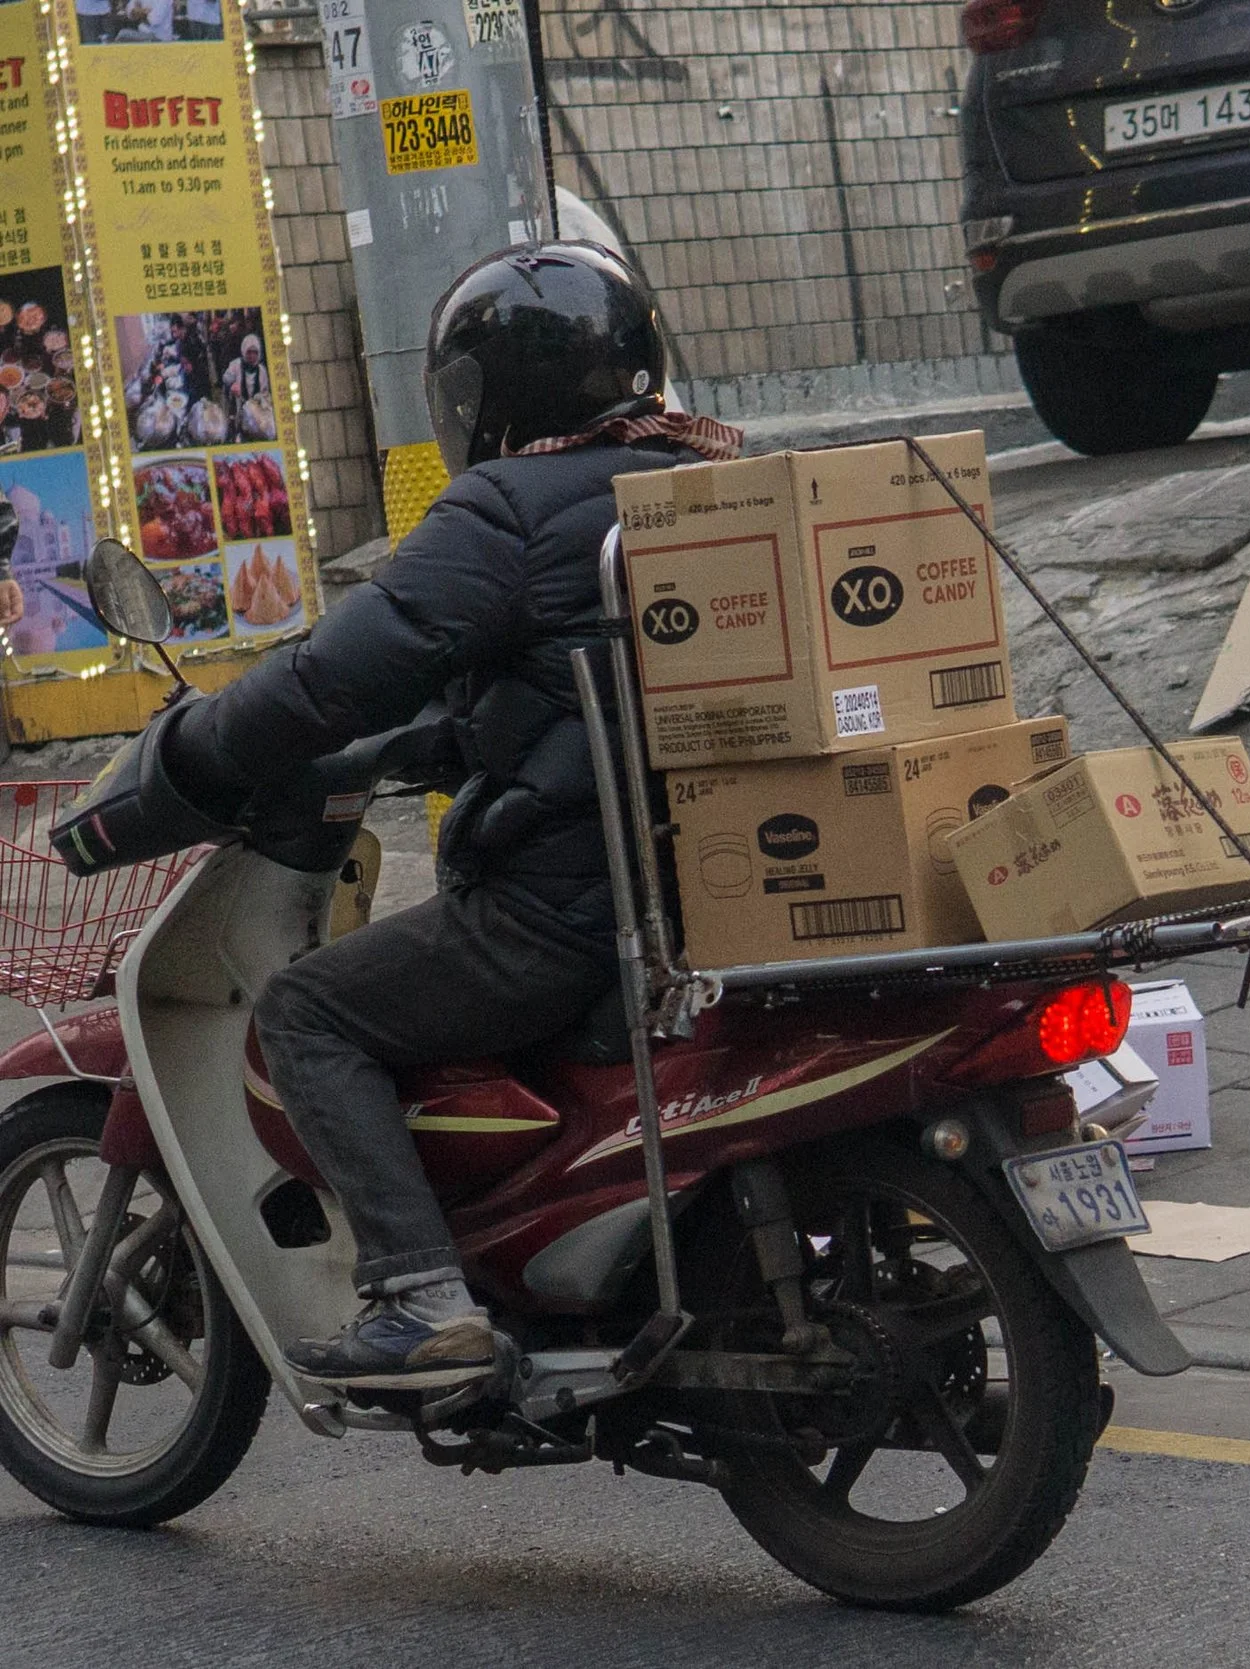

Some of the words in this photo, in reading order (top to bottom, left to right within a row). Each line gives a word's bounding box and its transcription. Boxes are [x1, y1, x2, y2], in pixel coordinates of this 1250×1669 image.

[332, 26, 361, 69] 47
[392, 94, 457, 117] 하나인력
[104, 135, 119, 150] Fri
[121, 134, 157, 150] dinner
[160, 134, 184, 151] only
[186, 132, 204, 147] Sat
[206, 131, 226, 146] and
[166, 155, 188, 171] and
[189, 155, 225, 169] dinner
[160, 181, 173, 193] to
[177, 177, 202, 193] 9.30
[203, 178, 221, 194] pm
[143, 259, 225, 280] 외국인관광식당
[145, 279, 227, 300] 인도요리전문점
[889, 474, 906, 486] 420
[961, 466, 981, 480] bags
[752, 496, 775, 508] bags
[915, 556, 978, 582] COFFEE
[709, 592, 769, 612] COFFEE
[922, 580, 976, 605] CANDY
[715, 610, 767, 630] CANDY
[654, 712, 694, 726] UNIVERSAL
[726, 703, 787, 719] CORPORATION
[658, 740, 702, 754] PRODUCT
[703, 739, 715, 751] OF
[718, 736, 737, 749] THE
[737, 731, 792, 747] PHILIPPINES
[903, 758, 920, 782] 24
[674, 781, 697, 805] 24
[763, 827, 813, 845] Vaseline
[765, 865, 797, 876] HEALING
[797, 863, 819, 873] JELLY
[1057, 1180, 1137, 1229] 1931
